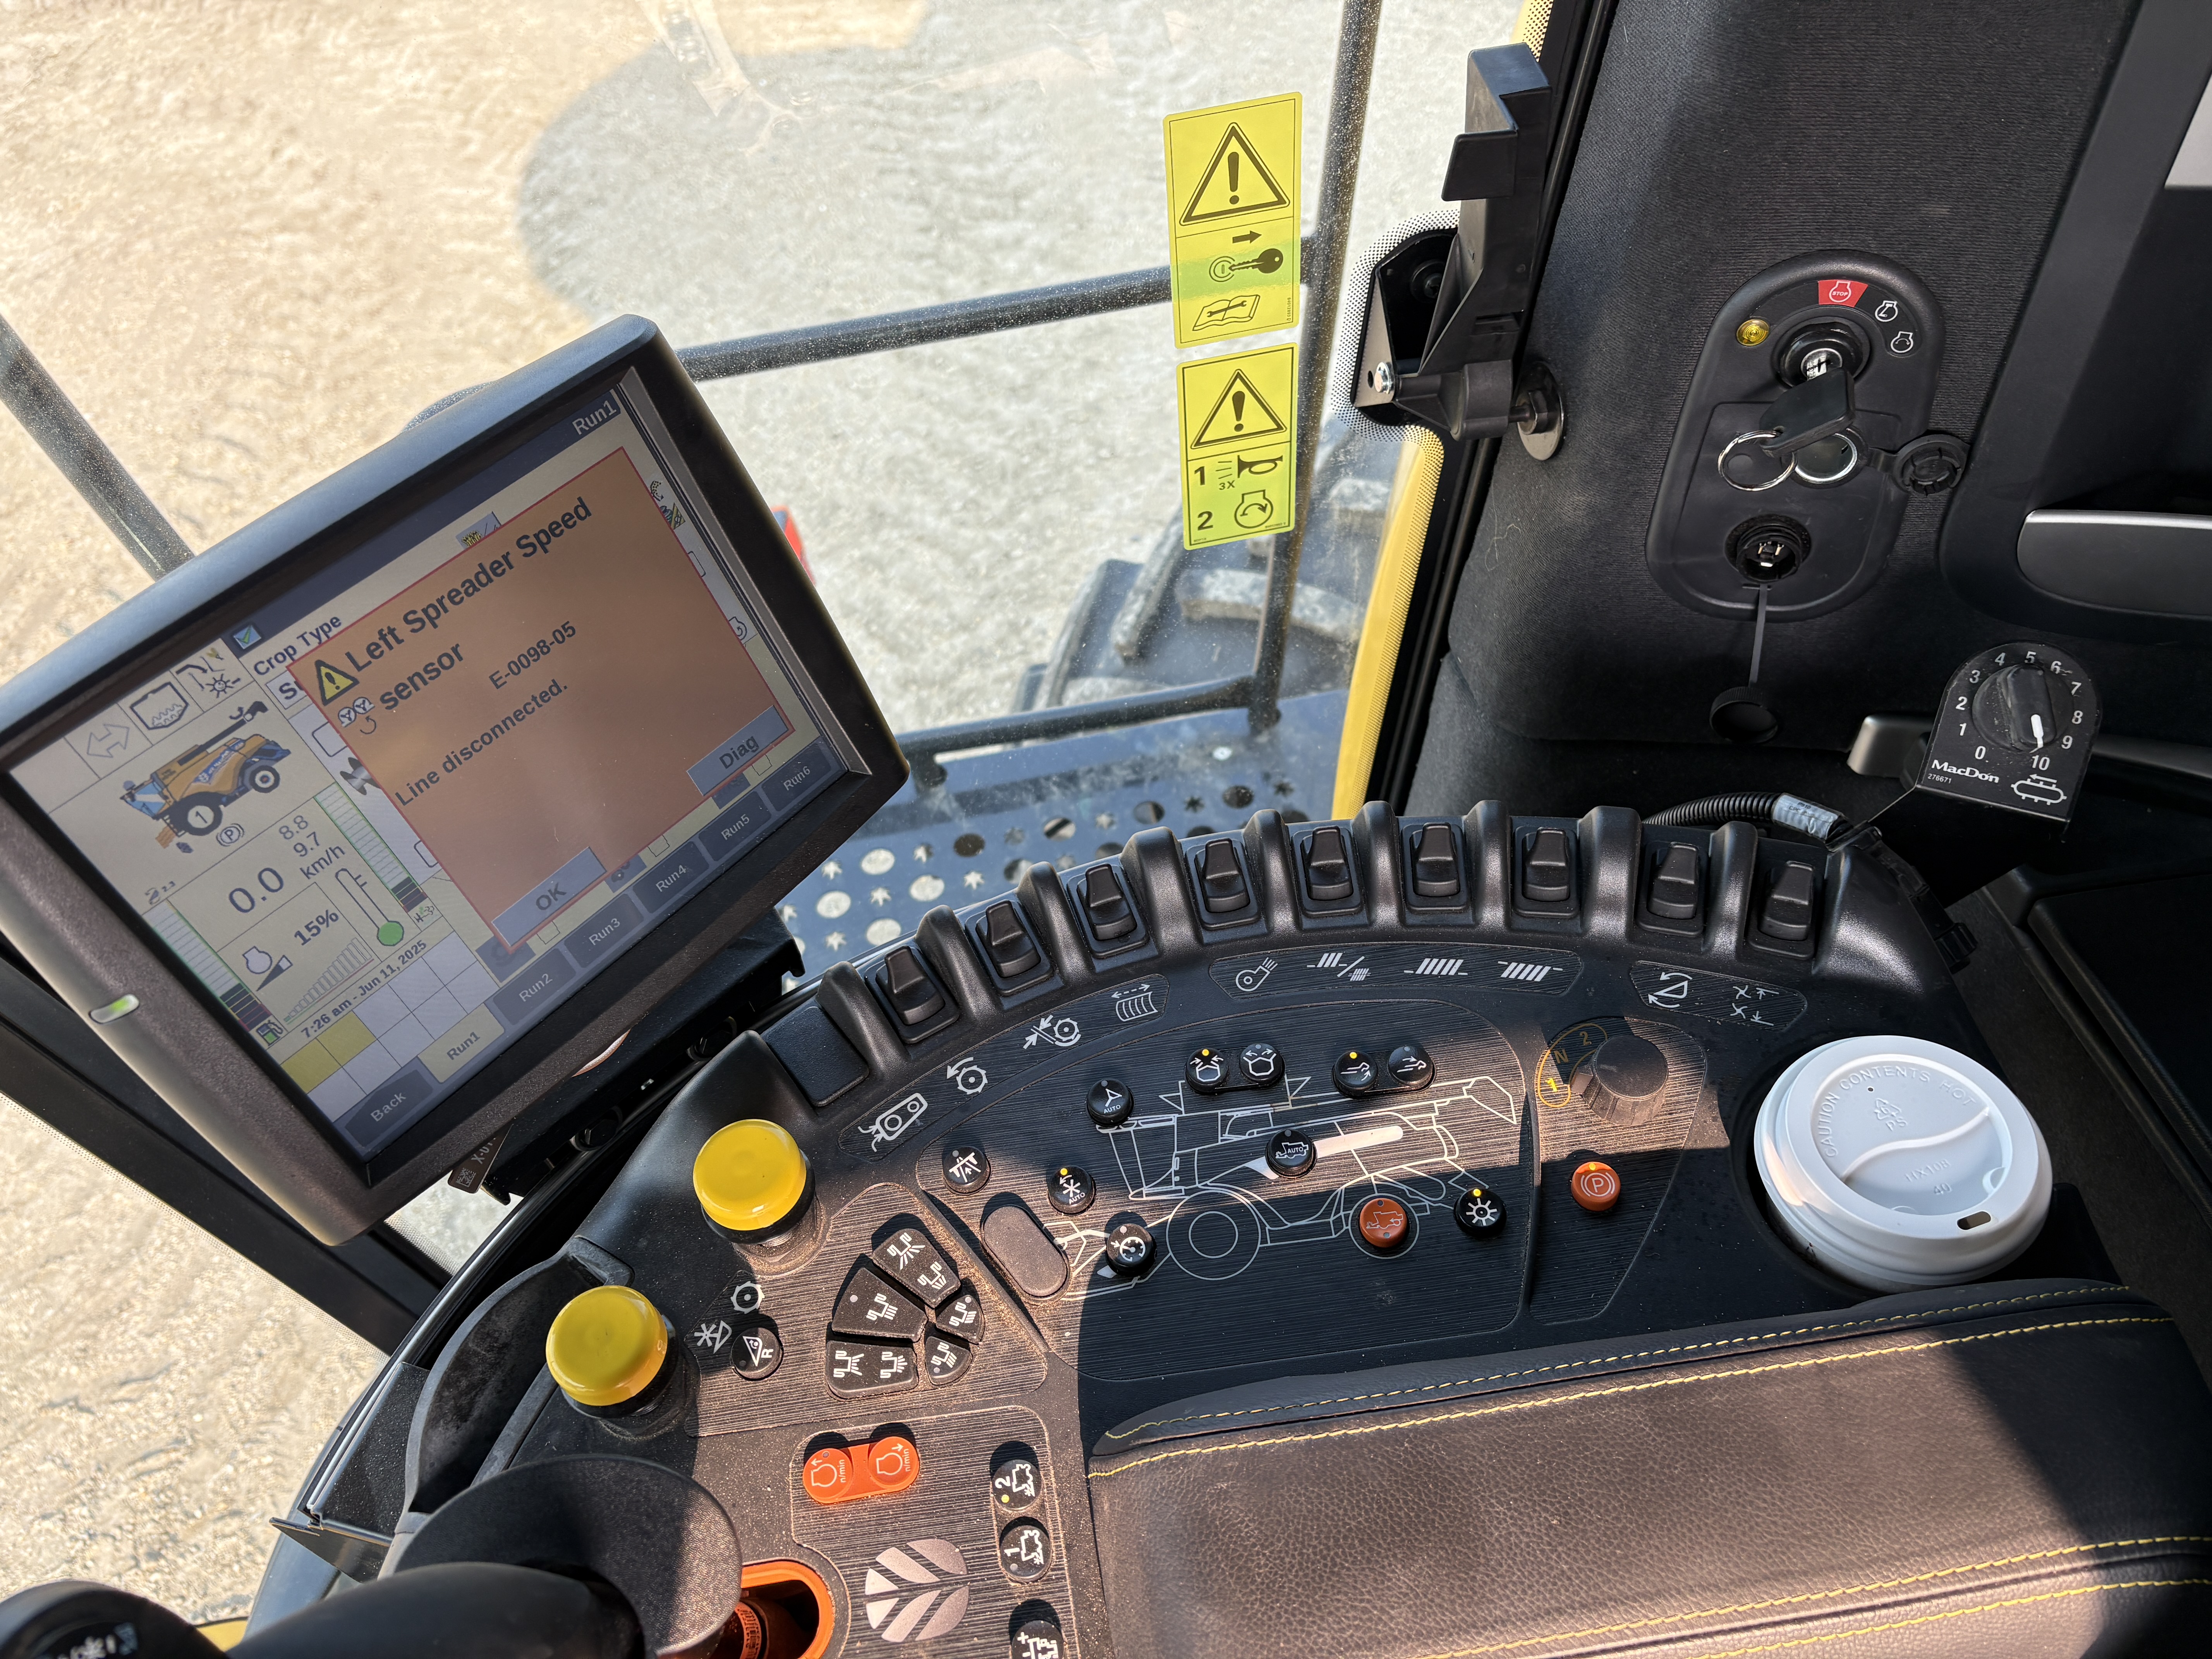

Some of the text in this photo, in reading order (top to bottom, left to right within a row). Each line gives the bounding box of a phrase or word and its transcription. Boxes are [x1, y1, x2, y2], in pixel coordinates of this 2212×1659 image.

[572, 400, 617, 434] Run1
[1194, 466, 1206, 485] 1
[1219, 480, 1235, 490] 3X
[1197, 511, 1213, 531] 2
[345, 496, 592, 672] Left Spreader Speed
[254, 615, 342, 676] Crop Type
[489, 621, 576, 689] E-0098-05
[1995, 653, 2006, 665] 4
[2025, 651, 2036, 663] 5
[380, 643, 464, 710] sensor
[1970, 670, 1980, 683] 3
[2051, 661, 2061, 674] 6
[2071, 682, 2081, 695] 7
[1956, 696, 1967, 710] 2
[2072, 711, 2083, 724] 8
[1959, 723, 1967, 735] 1
[395, 679, 568, 806] Line disconnected.
[2061, 736, 2073, 749] 9
[719, 736, 759, 769] Diag
[1975, 746, 1986, 759] 0
[1932, 759, 1999, 783] MacDon
[2032, 756, 2050, 770] 10
[783, 766, 811, 790] Run6
[1928, 773, 1952, 784] 276671
[279, 815, 309, 840] 8.8
[721, 814, 750, 840] Run5
[293, 832, 321, 857] 9.7
[300, 845, 345, 880] km/h
[656, 864, 686, 892] Run4
[228, 867, 284, 913] 0.0
[535, 882, 567, 911] OK
[294, 909, 339, 946] 15%
[589, 917, 620, 946] Run3
[301, 1013, 331, 1039] 7:26
[332, 1000, 352, 1017] am
[358, 977, 381, 996] Jun
[398, 939, 426, 965] 2025
[519, 973, 553, 1002] Run2
[446, 1030, 480, 1060] Run1
[1580, 1032, 1592, 1046] 2
[1554, 1049, 1569, 1064] N
[1547, 1078, 1558, 1092] 1
[370, 1091, 406, 1122] Back
[1104, 1105, 1121, 1114] AUTO
[1819, 1066, 1976, 1157] CAUTION CONTENTS HOT
[1886, 1117, 1908, 1131] PS
[1592, 1178, 1604, 1192] P
[1934, 1183, 1952, 1195] 40
[1068, 1192, 1085, 1204] AUTO
[761, 1349, 774, 1358] R
[996, 1475, 1011, 1488] 2
[1005, 1547, 1020, 1557] 1
